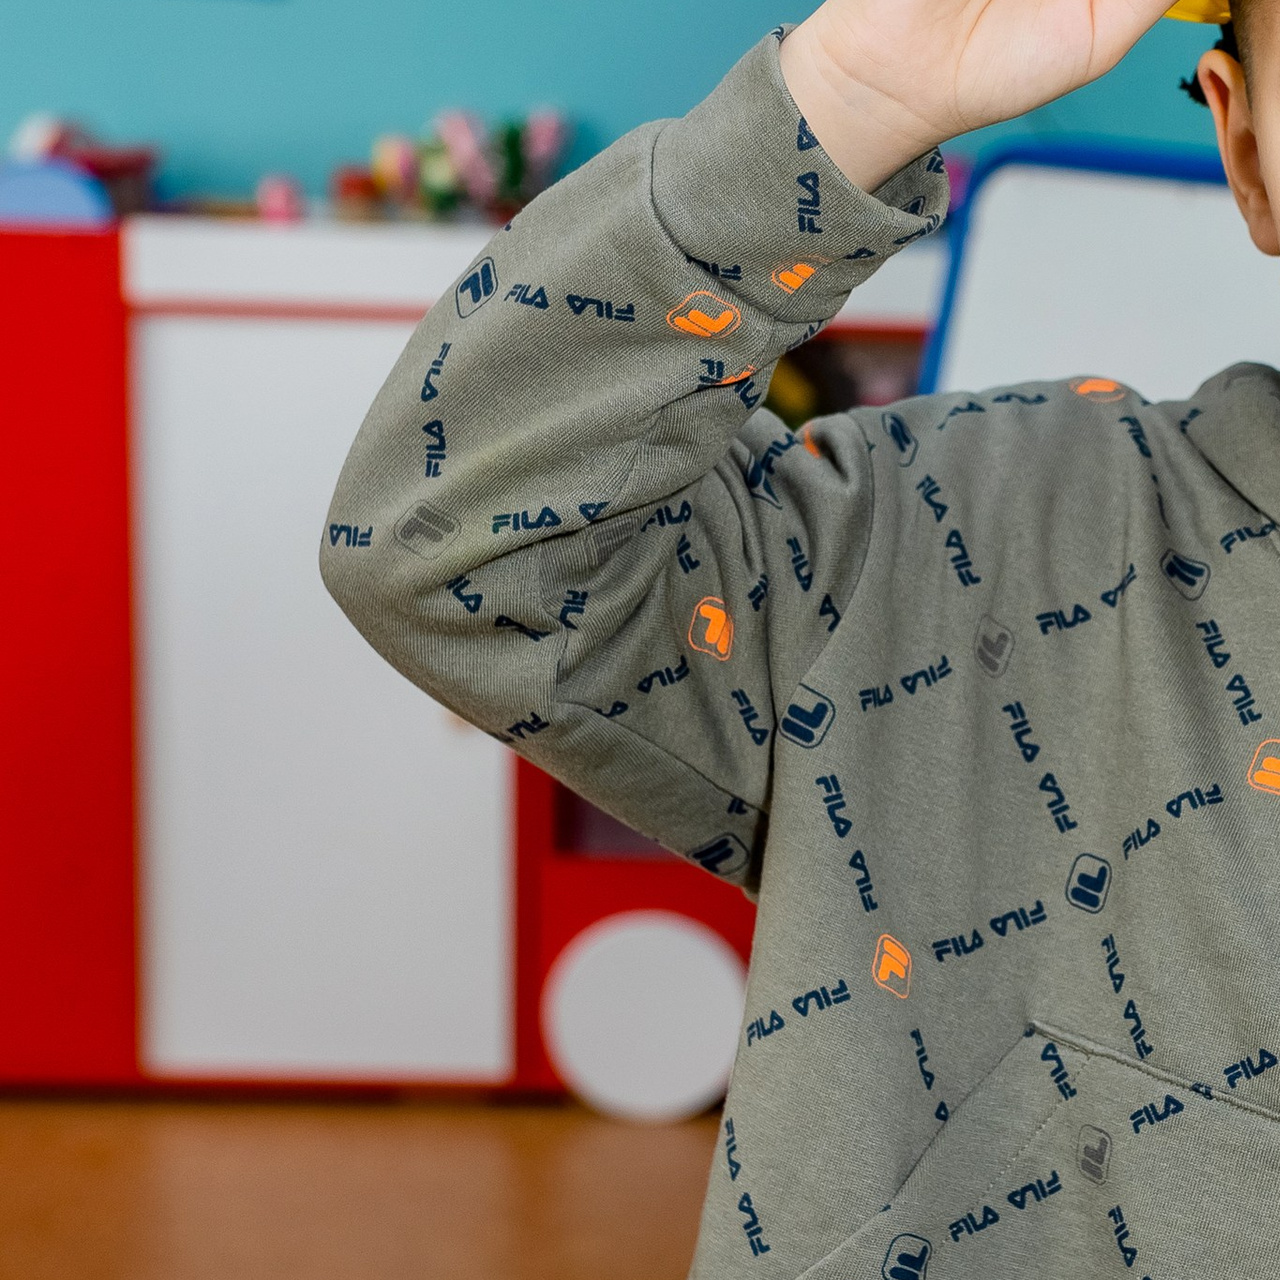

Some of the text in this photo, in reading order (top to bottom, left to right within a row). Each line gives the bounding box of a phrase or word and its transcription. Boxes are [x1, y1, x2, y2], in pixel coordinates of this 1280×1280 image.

[797, 172, 824, 236] FILA
[566, 295, 636, 324] FILA
[422, 420, 448, 479] FILA
[493, 507, 563, 535] FILA
[916, 475, 950, 524] FILA
[330, 524, 374, 549] FILA
[945, 529, 983, 589] FILA
[787, 537, 815, 594] FILA
[1036, 604, 1093, 637] FILA
[1197, 620, 1232, 670] FILA
[639, 659, 690, 694] FILA
[901, 655, 954, 696] FILA
[731, 690, 770, 747] FILA
[859, 687, 894, 714] FILA
[1226, 675, 1263, 728] FILA
[1003, 702, 1042, 765] FILA
[816, 775, 854, 840] FILA
[1039, 773, 1079, 834] FILA
[1166, 784, 1226, 820] FILA
[1124, 820, 1162, 860] FILA
[849, 850, 880, 914] FILA
[989, 900, 1049, 938] FILA
[932, 930, 986, 964] FILA
[1102, 935, 1126, 994] FILA
[792, 980, 853, 1018] FILA
[748, 1011, 786, 1046] FILA
[1124, 1000, 1155, 1061] FILA
[910, 1030, 936, 1092] FILA
[1041, 1043, 1079, 1101] FILA
[1224, 1049, 1280, 1090] FILA
[1130, 1095, 1186, 1136] FILA
[1007, 1171, 1063, 1211] FILA
[739, 1193, 772, 1258] FILA
[949, 1206, 1001, 1244] FILA
[1109, 1207, 1139, 1269] FILA
